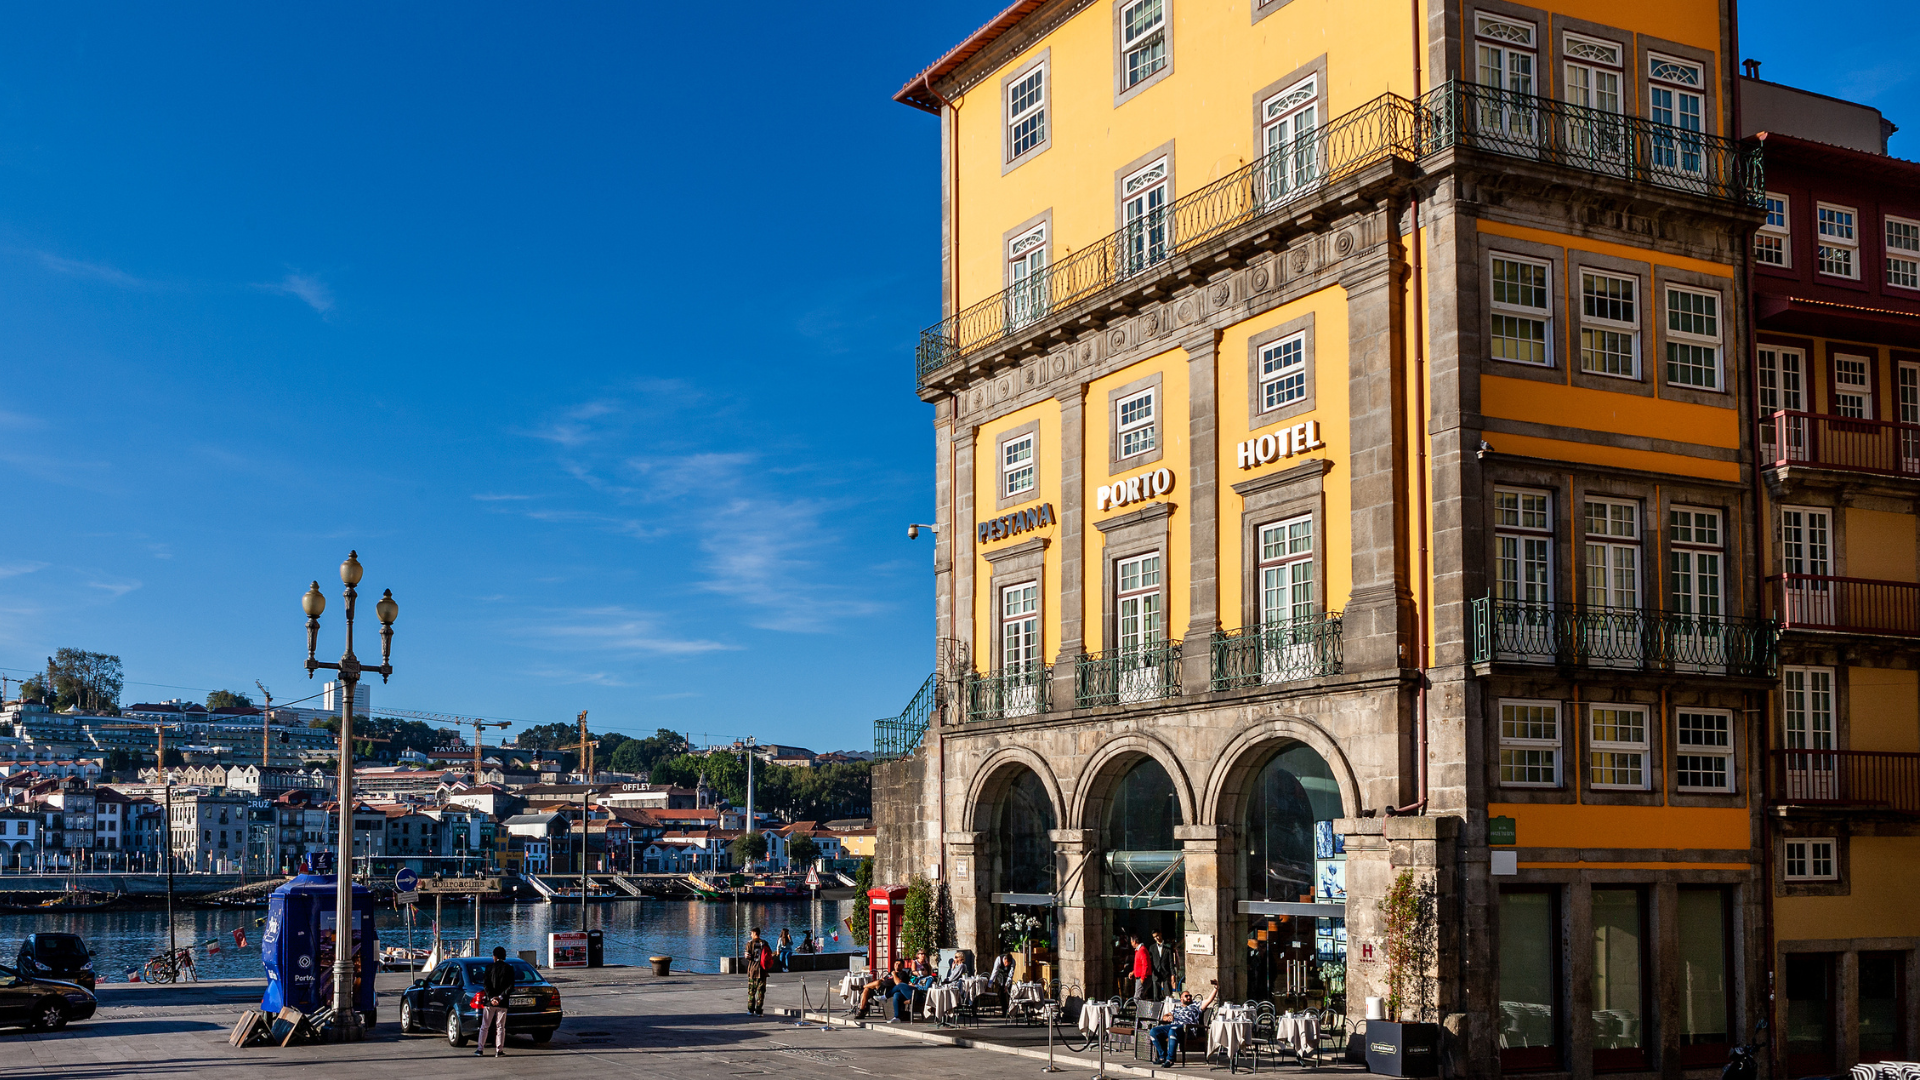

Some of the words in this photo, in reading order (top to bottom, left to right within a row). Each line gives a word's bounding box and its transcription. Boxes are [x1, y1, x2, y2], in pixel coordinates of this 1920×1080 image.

[978, 503, 1055, 543] PESTANA
[1097, 468, 1174, 511] PORTO
[1237, 420, 1323, 469] HOTEL
[622, 783, 651, 791] OFFLEY
[248, 800, 270, 808] CRUZ
[432, 880, 484, 888] douroacima
[1363, 944, 1372, 957] H
